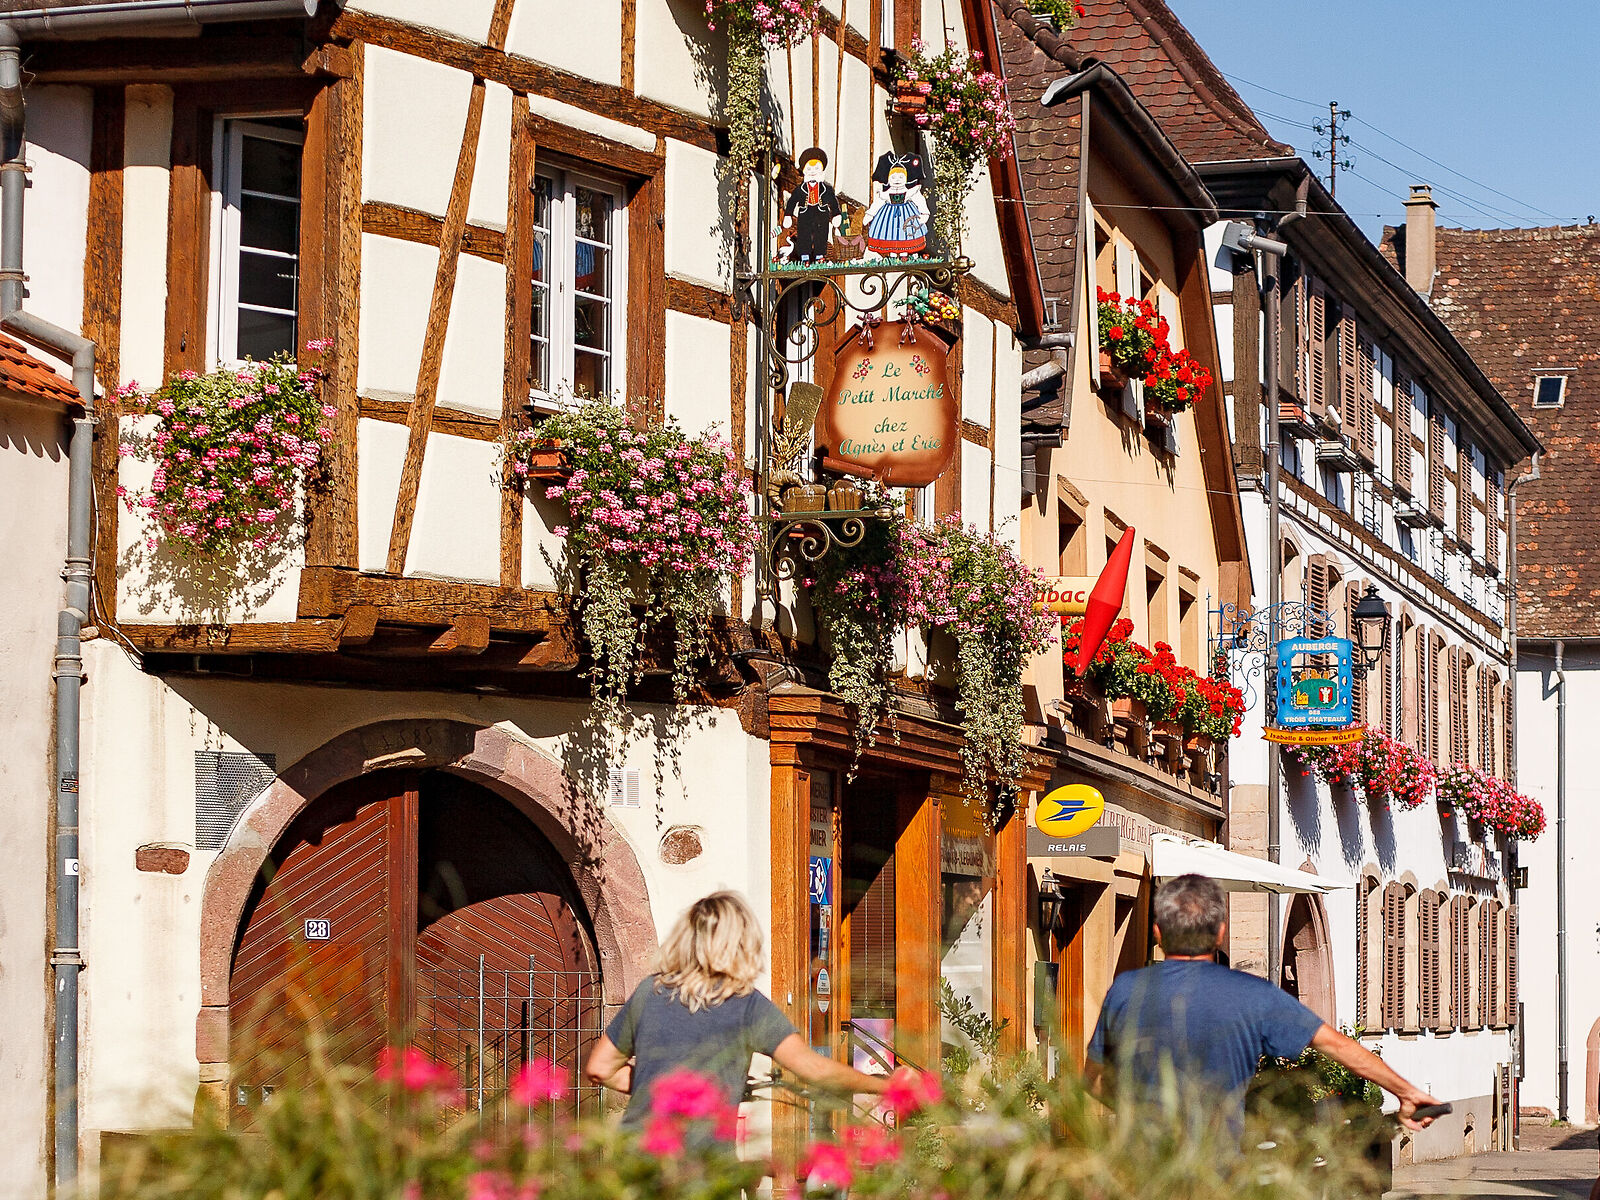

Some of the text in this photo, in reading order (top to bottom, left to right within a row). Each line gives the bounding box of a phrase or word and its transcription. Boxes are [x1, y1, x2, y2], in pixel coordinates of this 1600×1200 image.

[881, 362, 902, 378] Le
[837, 383, 944, 405] Petit Marché
[874, 417, 908, 434] chez
[839, 435, 942, 459] Agnès et Eric
[1291, 642, 1339, 651] AUBERGE
[1047, 844, 1087, 852] RELAIS
[308, 921, 327, 937] 28
